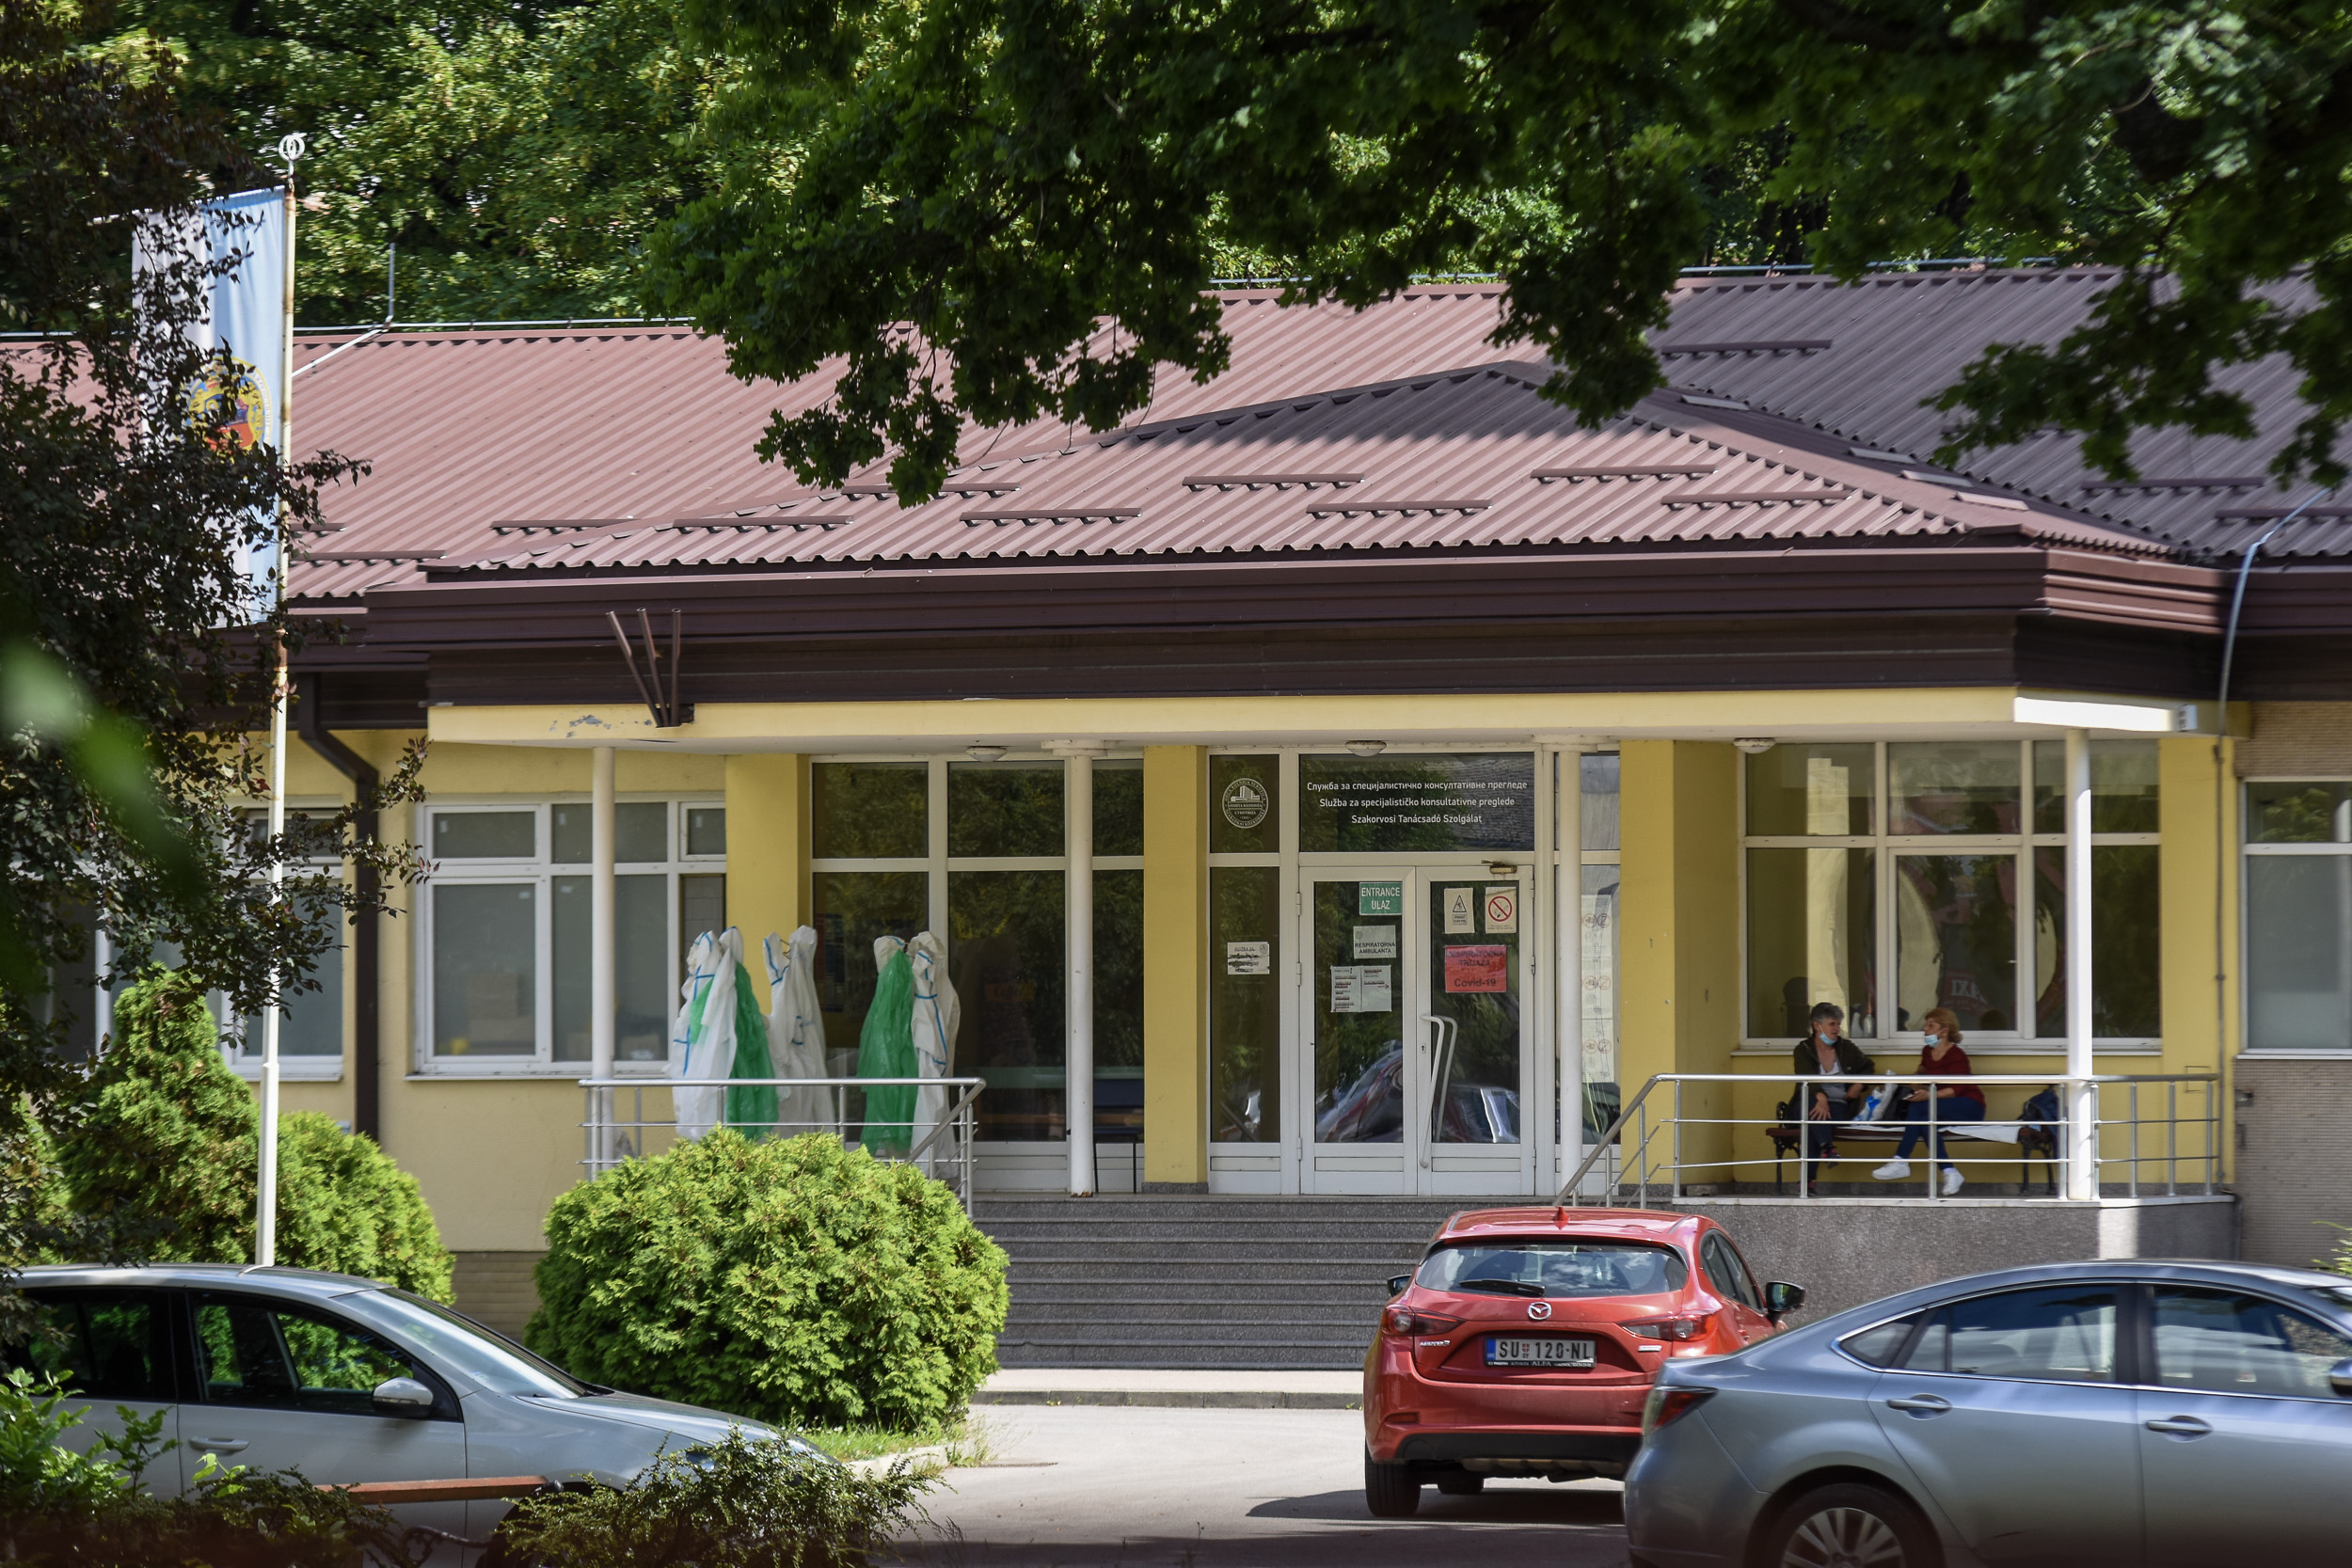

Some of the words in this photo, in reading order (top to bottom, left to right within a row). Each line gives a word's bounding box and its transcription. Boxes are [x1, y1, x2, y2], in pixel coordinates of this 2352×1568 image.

[1307, 782, 1339, 792] Служба
[1352, 782, 1422, 792] специјалистичко
[1424, 782, 1486, 791] консултативне
[1487, 782, 1528, 791] прегледе
[1319, 798, 1347, 807] Služba
[1349, 799, 1359, 807] za
[1360, 797, 1420, 808] specijalističko
[1421, 798, 1477, 806] konsultativne
[1479, 797, 1515, 808] preglede
[1351, 815, 1396, 824] Szakorvosi
[1398, 814, 1441, 823] Tanácsadó
[1443, 814, 1483, 824] Szolgálat
[1361, 887, 1400, 897] ENTRANCE
[1371, 899, 1391, 910] ULAZ
[1454, 978, 1497, 988] Covid-19
[1499, 1341, 1519, 1358] SU
